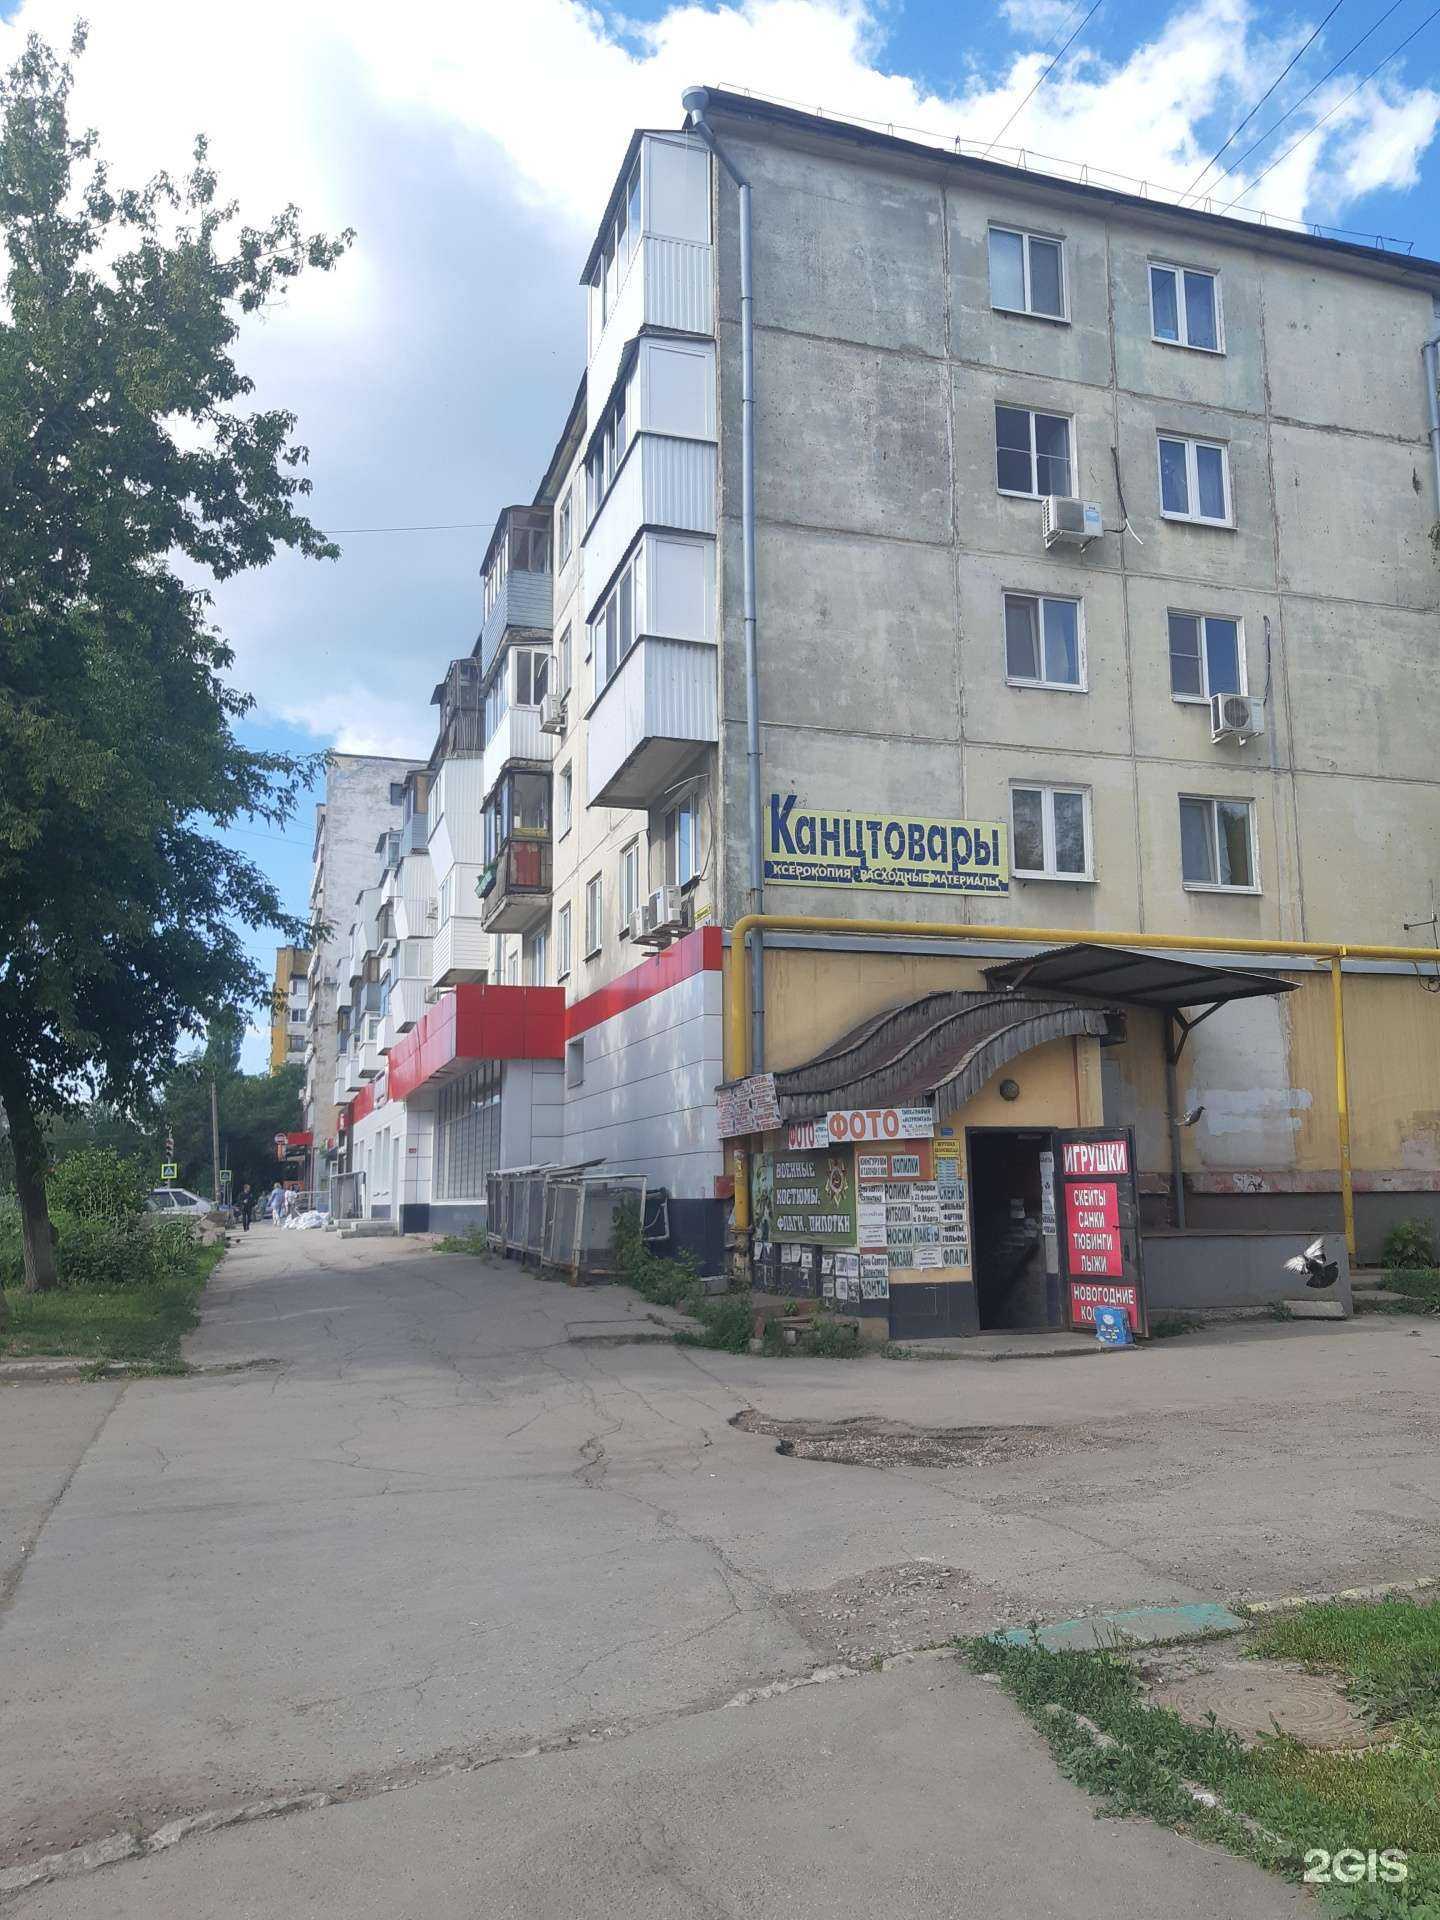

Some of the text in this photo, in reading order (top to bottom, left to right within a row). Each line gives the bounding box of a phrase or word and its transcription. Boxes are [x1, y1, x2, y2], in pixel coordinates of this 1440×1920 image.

[771, 794, 1000, 872] Канцтовары
[773, 864, 1000, 887] КСЕРОКОПИЯ РАСХОДНЫЕ МАТЕРИАЛЫ
[829, 1109, 899, 1140] ФОТО
[788, 1120, 815, 1148] ФОТО
[1064, 1143, 1127, 1172] ИГРУШКИ
[776, 1161, 816, 1179] ВОЕННЫЕ
[776, 1188, 821, 1206] КОСТЮМЫ,
[884, 1183, 910, 1200] РОЛИКИ
[1073, 1188, 1106, 1206] СКЕЙТЫ
[776, 1215, 850, 1233] ФЛАГИ, ПИЛОТКИ
[1078, 1211, 1105, 1228] САНКИ
[887, 1227, 912, 1244] НОСКИ
[1073, 1232, 1113, 1250] ТЮБИНГИ
[943, 1249, 969, 1265] ФЛАГИ
[1081, 1255, 1107, 1272] ЛЫЖИ
[1073, 1286, 1134, 1305] НОВОГОДНИЕ
